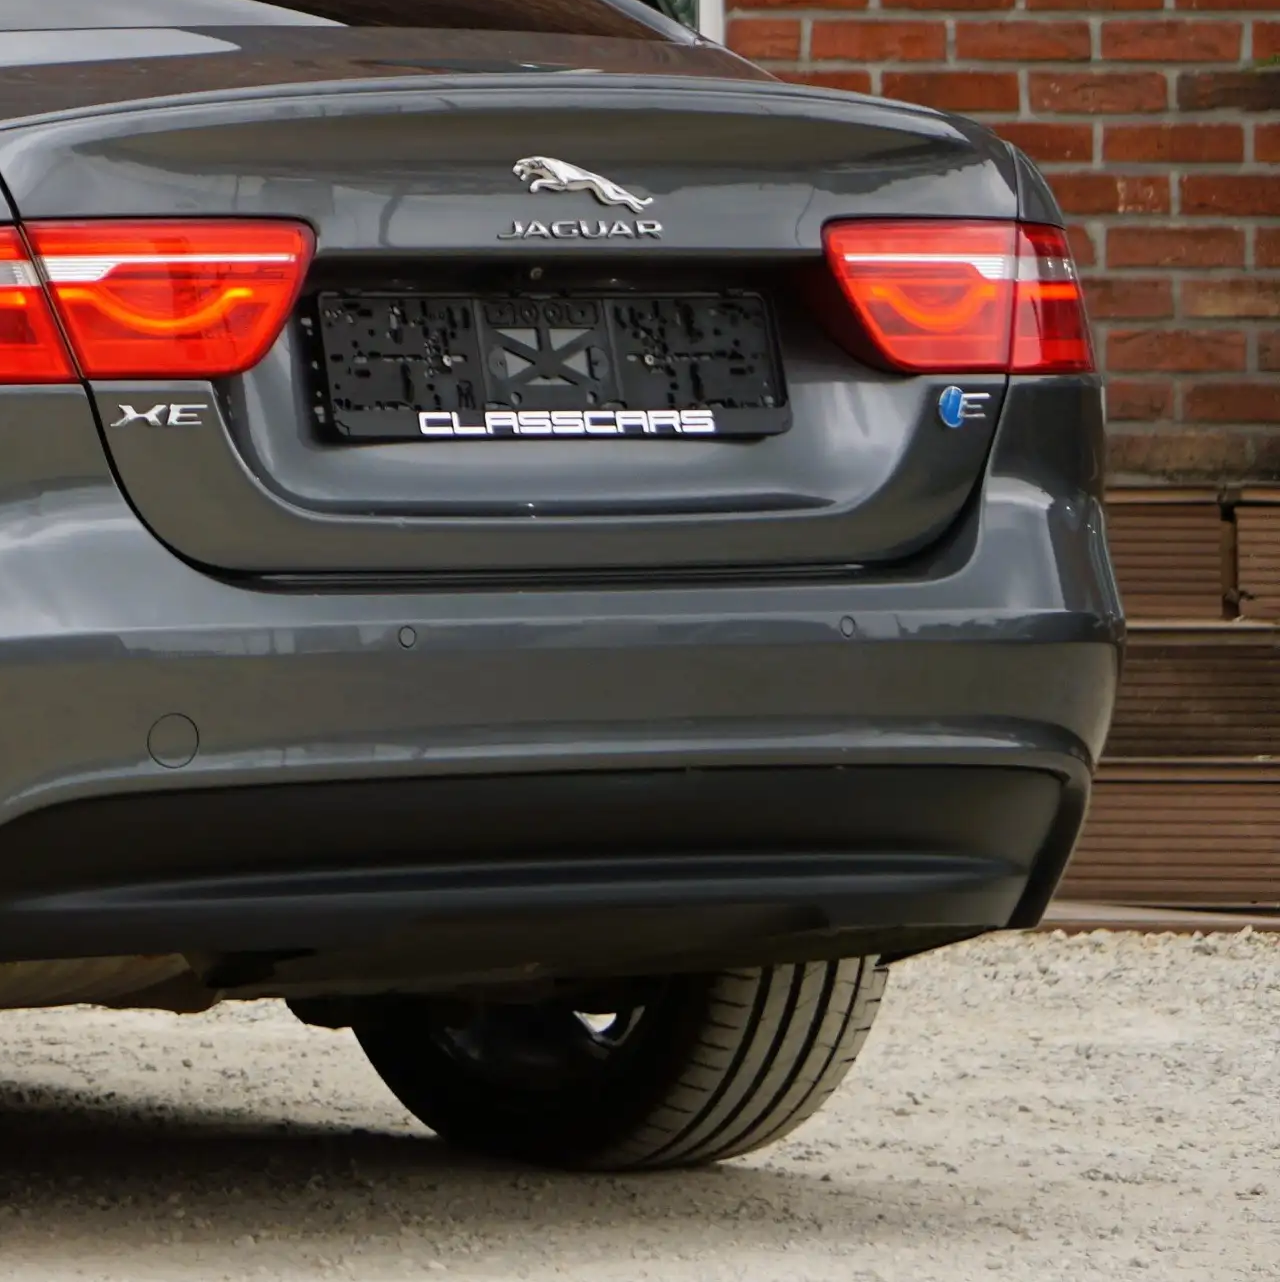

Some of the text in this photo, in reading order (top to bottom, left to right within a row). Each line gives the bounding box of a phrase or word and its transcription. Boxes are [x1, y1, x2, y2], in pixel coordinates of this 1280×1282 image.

[496, 219, 664, 239] JAGUAR
[109, 403, 209, 427] XE
[418, 408, 717, 435] CLASSCARS
